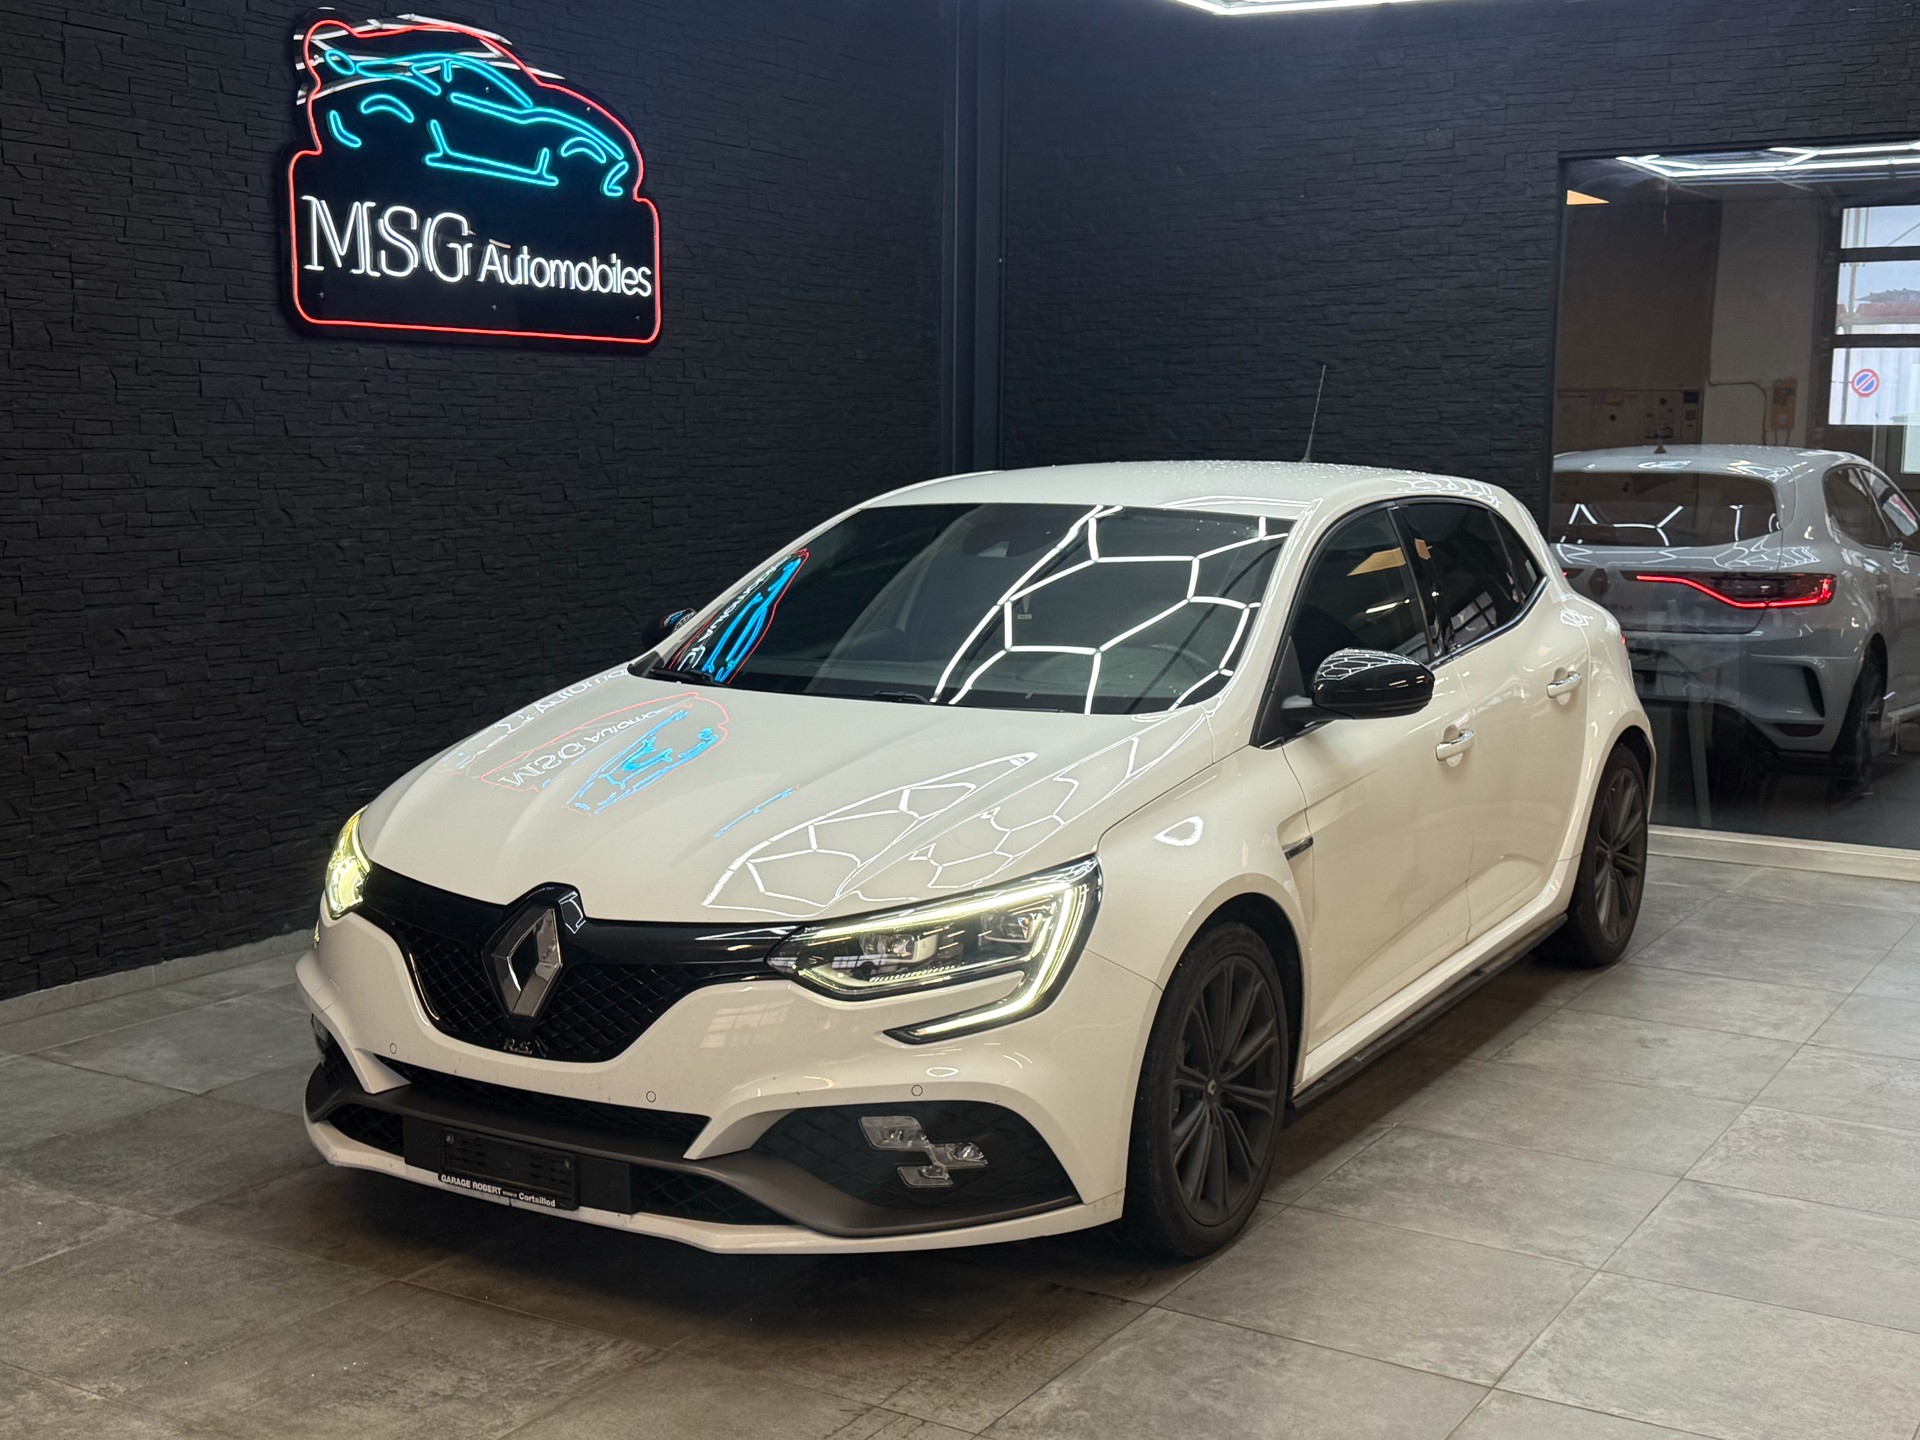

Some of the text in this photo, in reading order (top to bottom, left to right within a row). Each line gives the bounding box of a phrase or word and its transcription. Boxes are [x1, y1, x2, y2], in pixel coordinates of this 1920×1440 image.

[301, 195, 653, 297] MSG Automobiles
[441, 1174, 471, 1188] GARAGE
[472, 1181, 502, 1195] ROBERT
